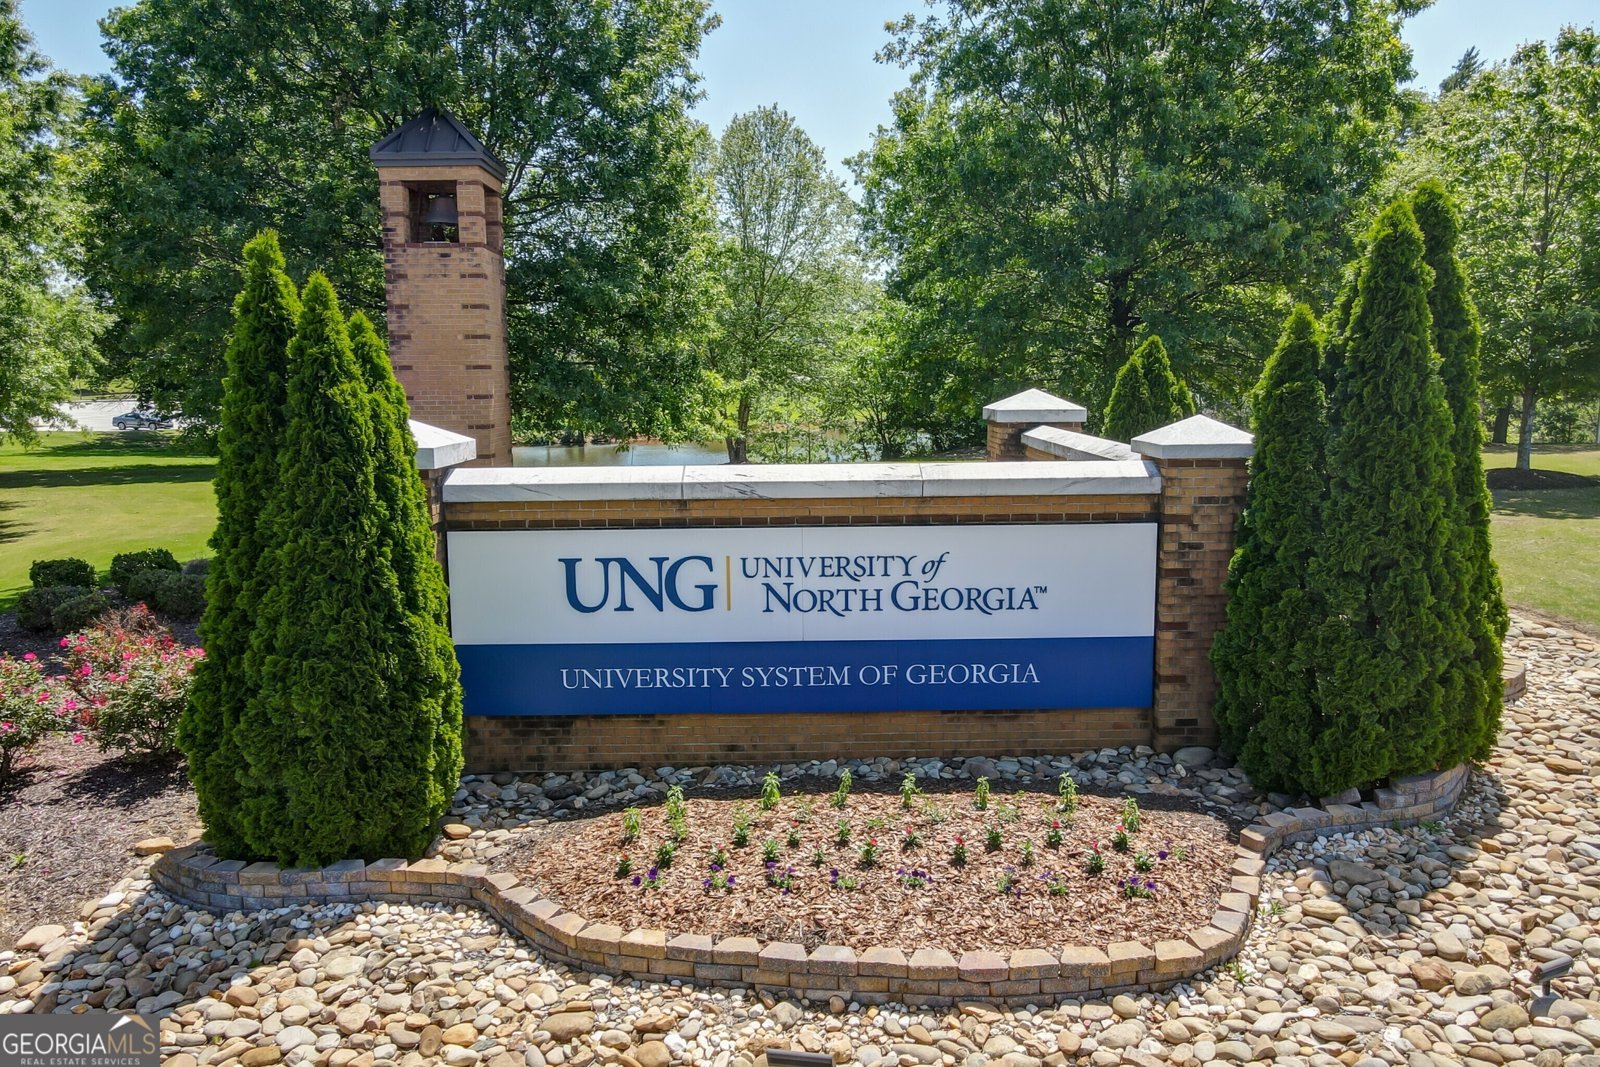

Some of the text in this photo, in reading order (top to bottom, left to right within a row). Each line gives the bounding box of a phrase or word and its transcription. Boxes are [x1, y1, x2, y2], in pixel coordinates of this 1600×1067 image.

[740, 551, 950, 583] UNIVERSITY of
[558, 556, 718, 613] UNG
[762, 582, 883, 617] NORTH
[560, 663, 1040, 689] UNIVERSITY SYSTEM OF GEORGIA
